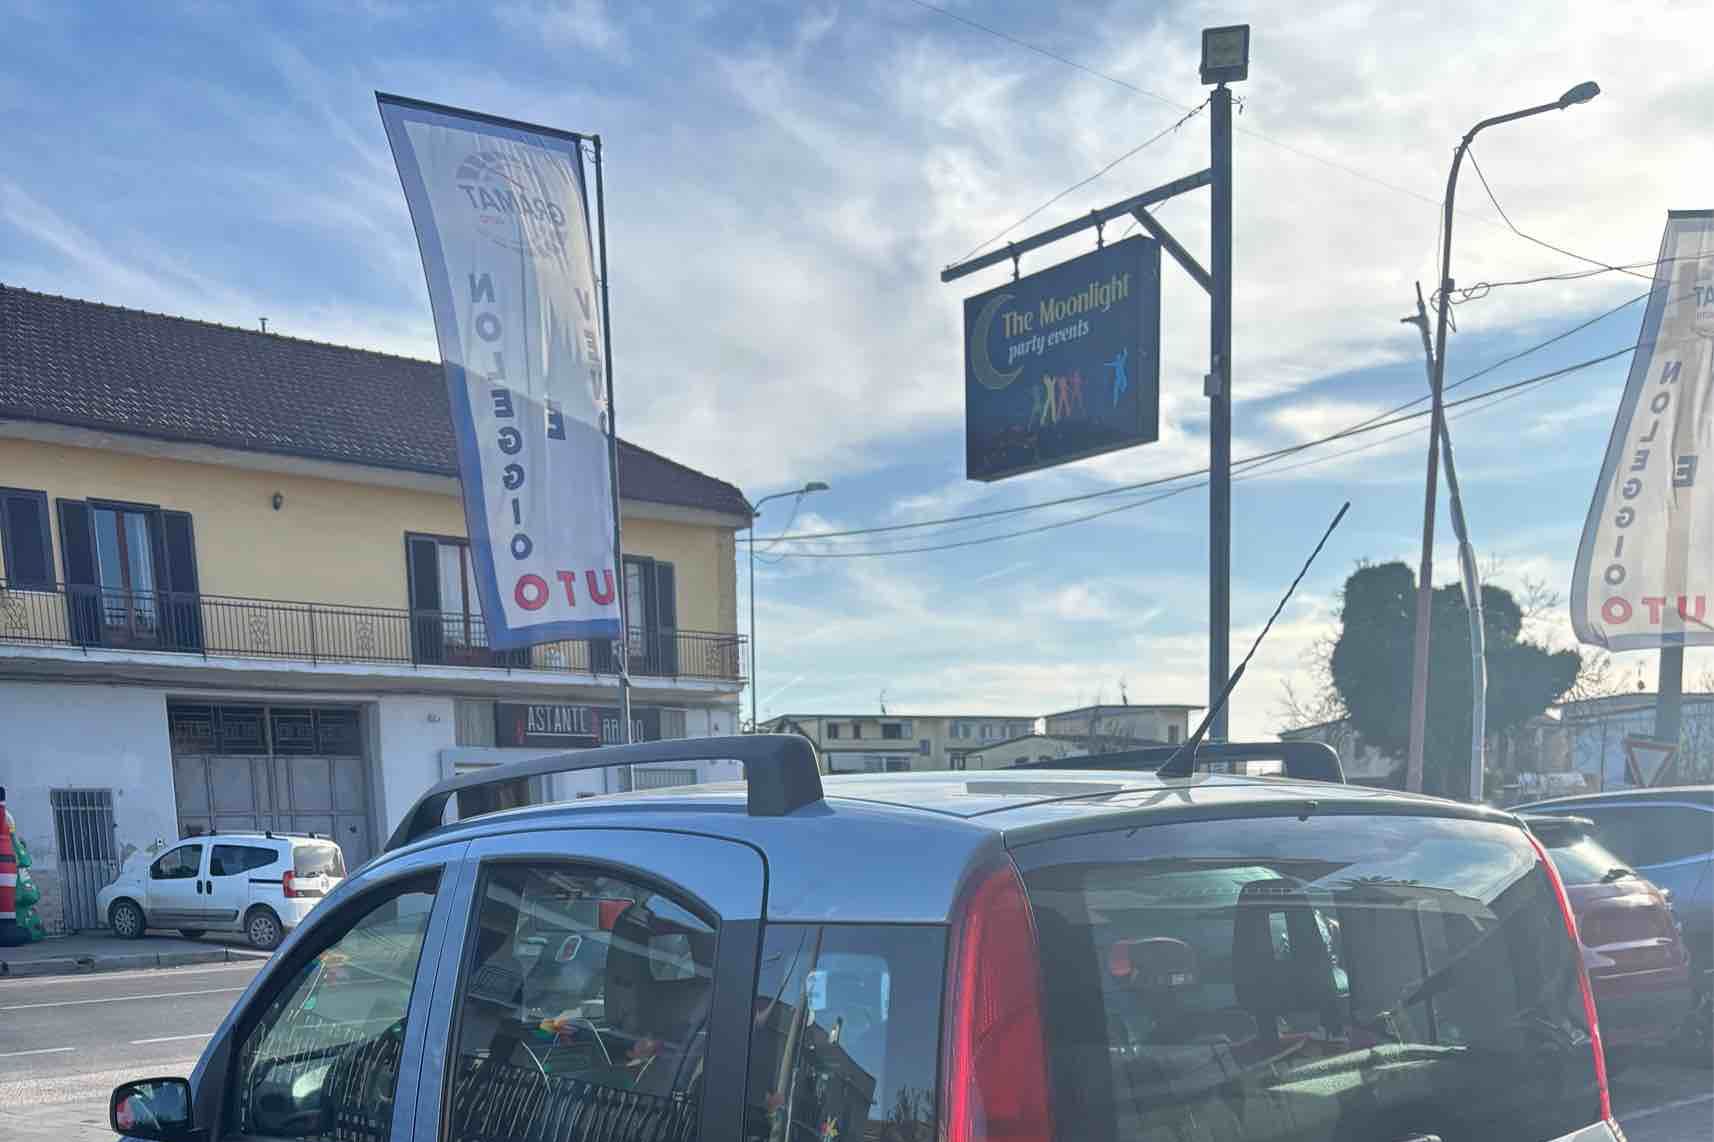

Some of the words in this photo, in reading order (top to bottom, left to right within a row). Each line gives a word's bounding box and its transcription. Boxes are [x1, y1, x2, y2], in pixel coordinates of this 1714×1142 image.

[1003, 311, 1033, 340] The
[1039, 272, 1131, 327] Moonlight
[1008, 334, 1045, 365] party
[1048, 320, 1090, 347] events
